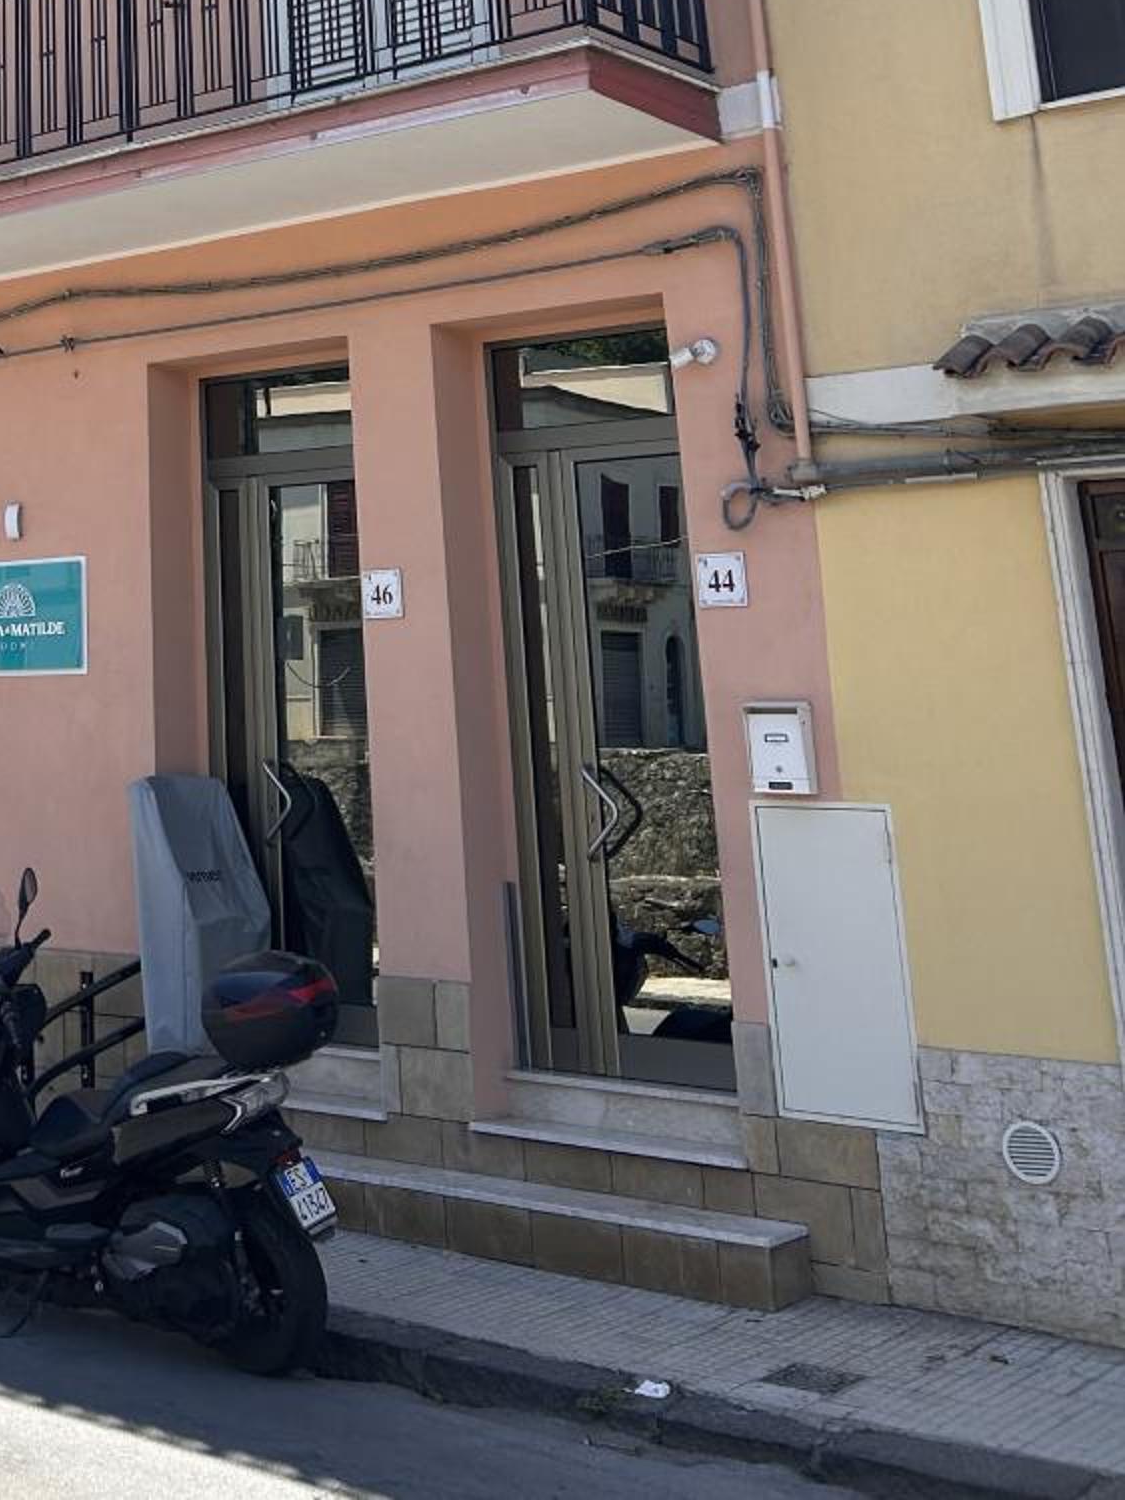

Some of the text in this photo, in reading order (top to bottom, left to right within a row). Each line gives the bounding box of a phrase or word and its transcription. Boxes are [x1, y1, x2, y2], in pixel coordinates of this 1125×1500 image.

[708, 569, 735, 593] 44
[370, 584, 394, 605] 46
[10, 621, 65, 637] MATILDE
